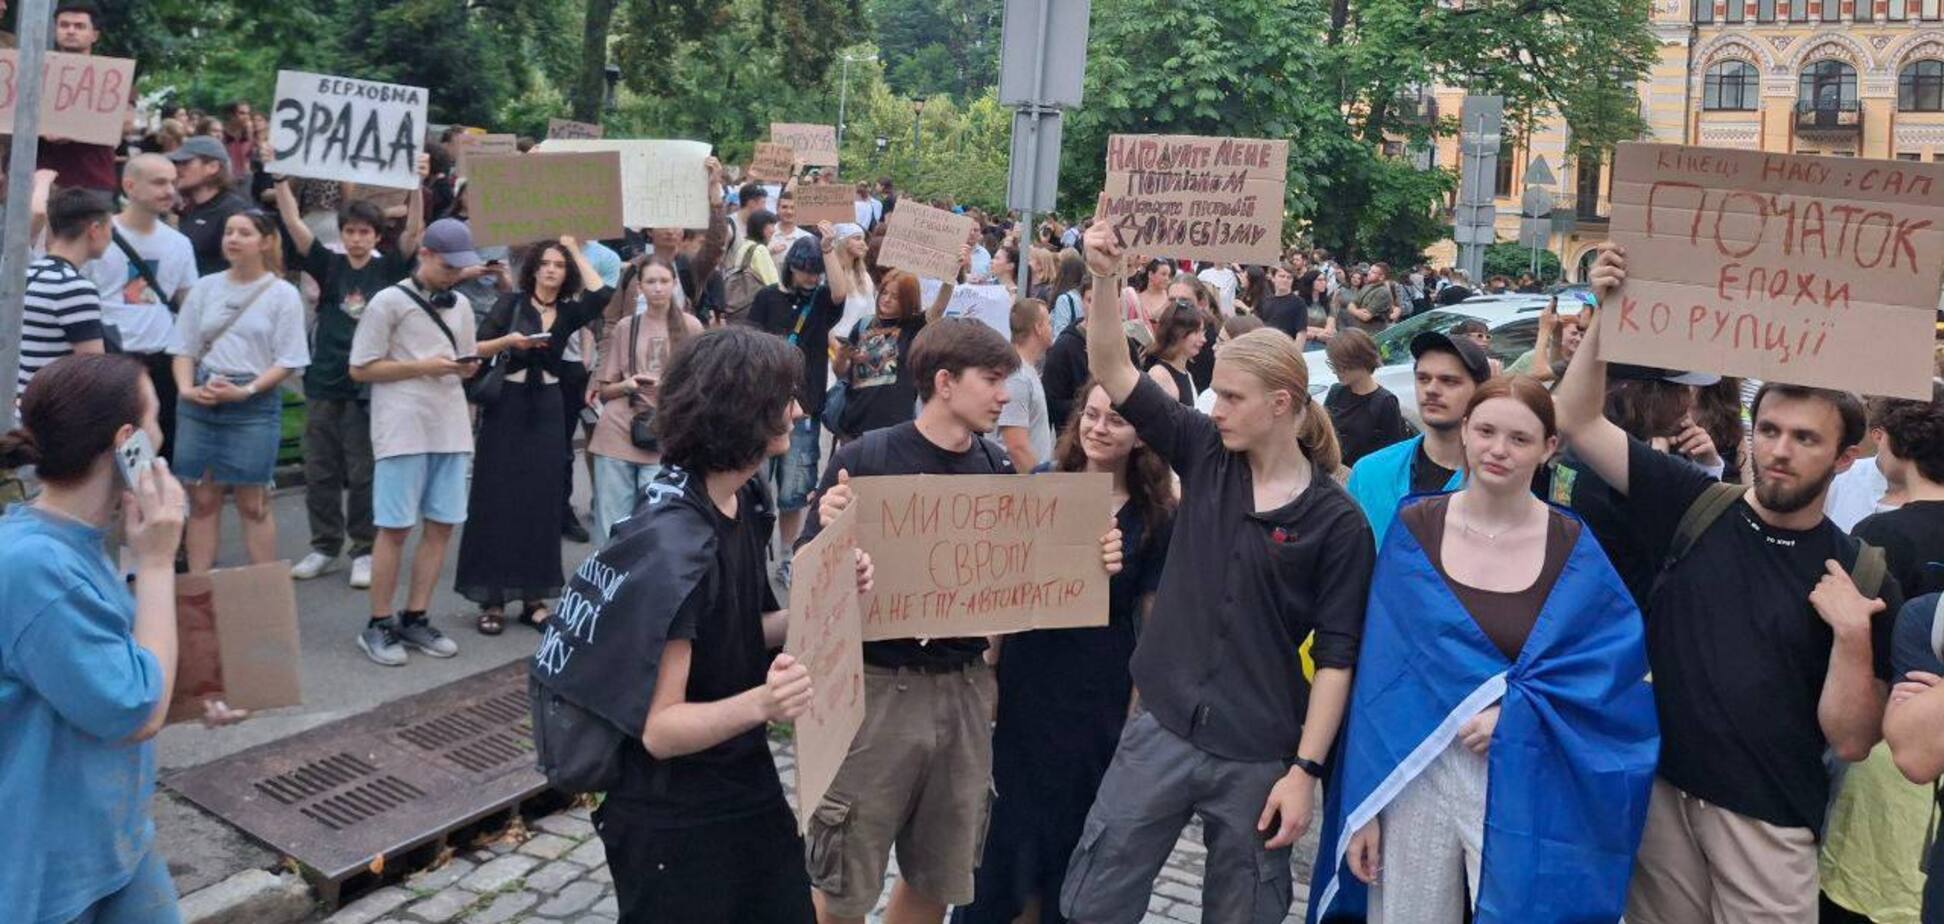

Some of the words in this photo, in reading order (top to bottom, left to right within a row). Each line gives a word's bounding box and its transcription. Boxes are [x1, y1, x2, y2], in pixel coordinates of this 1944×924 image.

[275, 98, 416, 173] ЗРАДА
[1214, 138, 1272, 169] МЕНЕ
[1858, 167, 1934, 196] САП
[1645, 179, 1934, 275] ПОЧАТОК
[1717, 262, 1850, 310] ЕПОХИ
[1617, 298, 1836, 364] КОРУПЦІЇ
[881, 491, 941, 539] МИ
[951, 492, 1058, 532] ОБРАЛИ
[928, 538, 1034, 590] ЄВРОПУ
